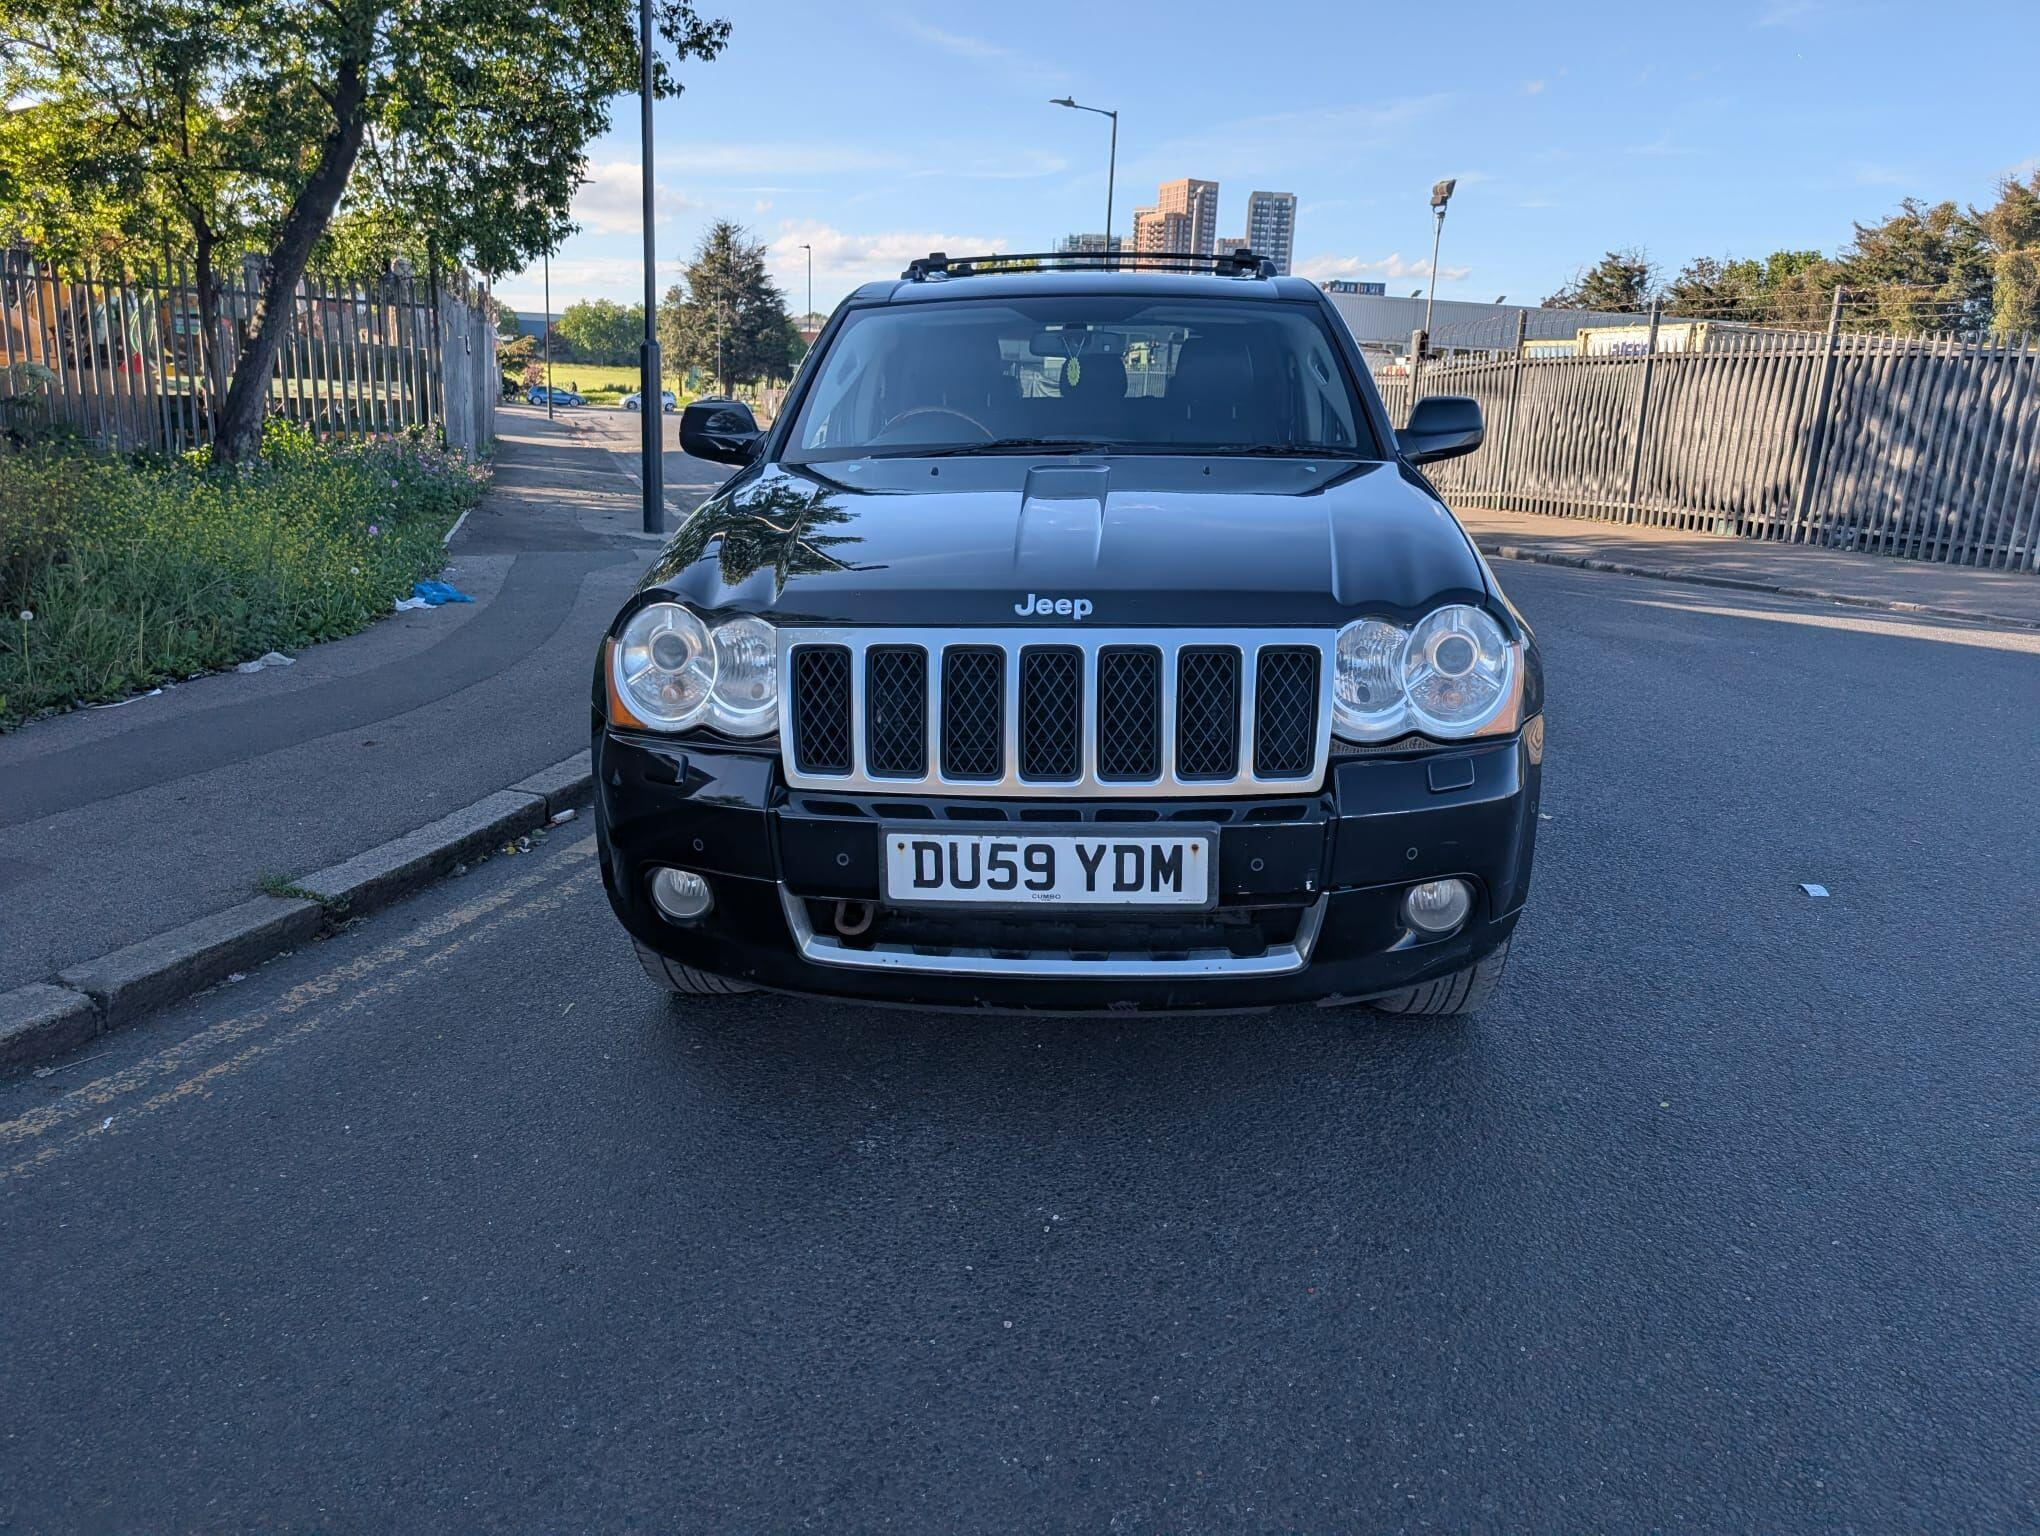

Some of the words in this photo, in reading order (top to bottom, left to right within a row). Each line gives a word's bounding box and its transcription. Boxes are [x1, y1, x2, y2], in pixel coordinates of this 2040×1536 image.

[1014, 593, 1093, 620] Jeep
[912, 841, 1056, 891] DU59
[1075, 844, 1184, 893] YDM
